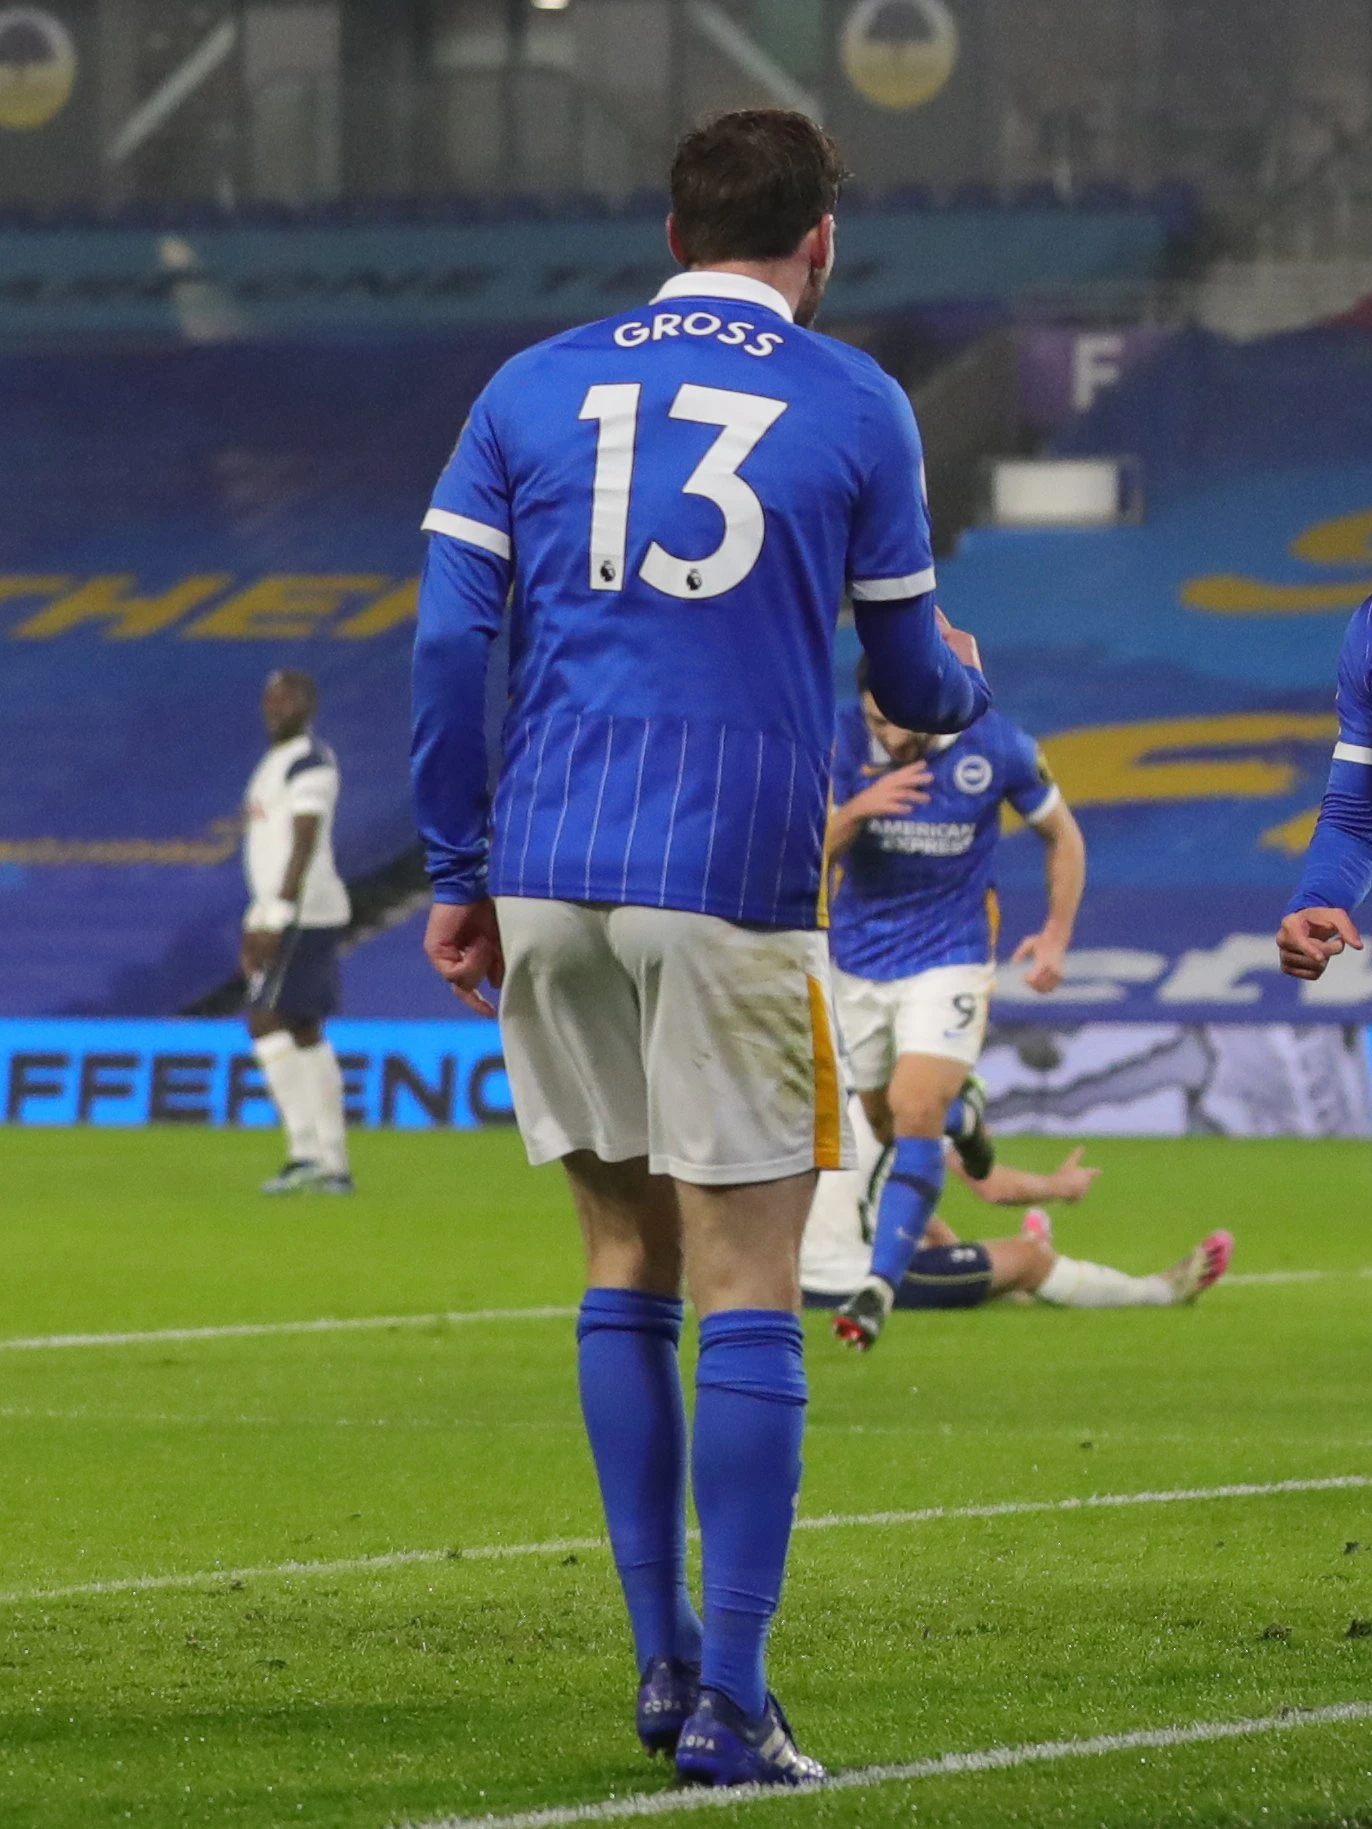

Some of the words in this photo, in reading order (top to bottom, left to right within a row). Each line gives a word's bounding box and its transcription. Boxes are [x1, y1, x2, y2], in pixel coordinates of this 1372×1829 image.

[613, 311, 784, 357] GROSS
[1072, 334, 1122, 411] F
[578, 382, 789, 600] 13
[952, 991, 976, 1029] 9
